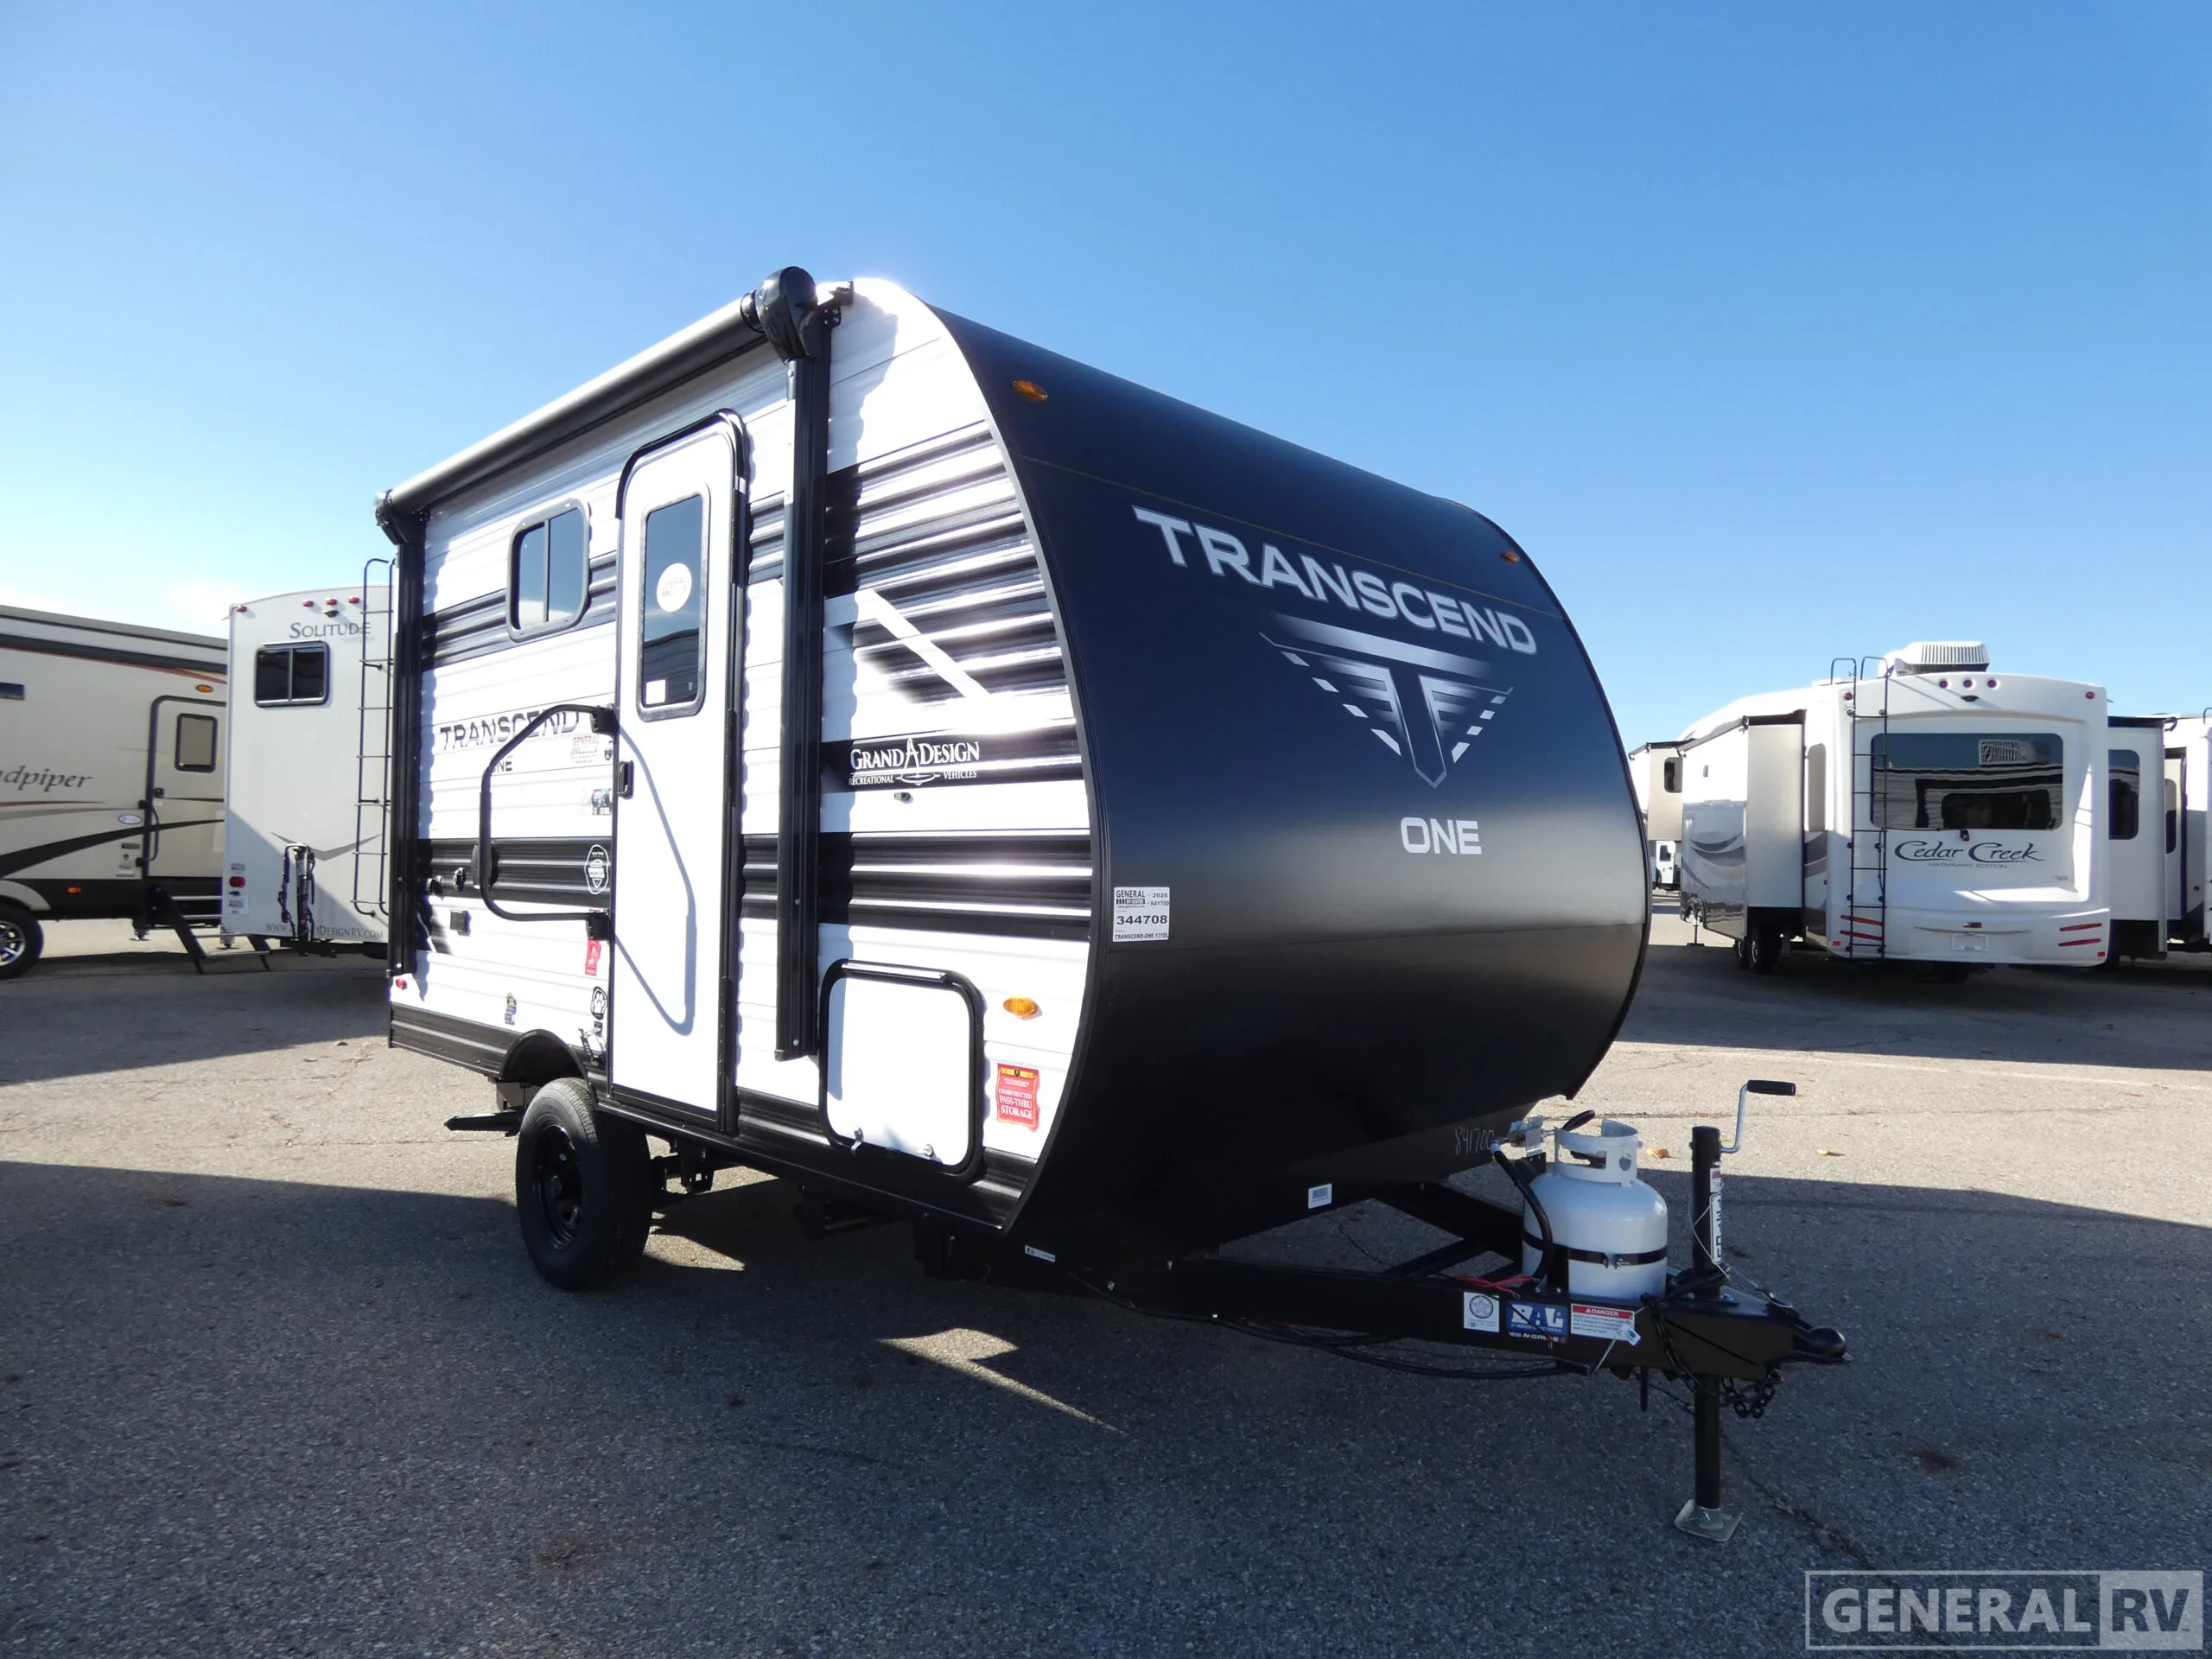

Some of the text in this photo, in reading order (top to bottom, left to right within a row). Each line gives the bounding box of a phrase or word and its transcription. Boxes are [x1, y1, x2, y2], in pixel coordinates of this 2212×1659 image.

[1131, 505, 1537, 655] TRANSCEND
[850, 741, 980, 770] GRAND DESIGN
[849, 770, 977, 785] RECREATIONAL VEHICLES
[1401, 817, 1482, 855] ONE
[1894, 841, 2046, 863] Cedar Creek
[1116, 915, 1167, 925] 344708
[1001, 1106, 1034, 1119] STORAGE
